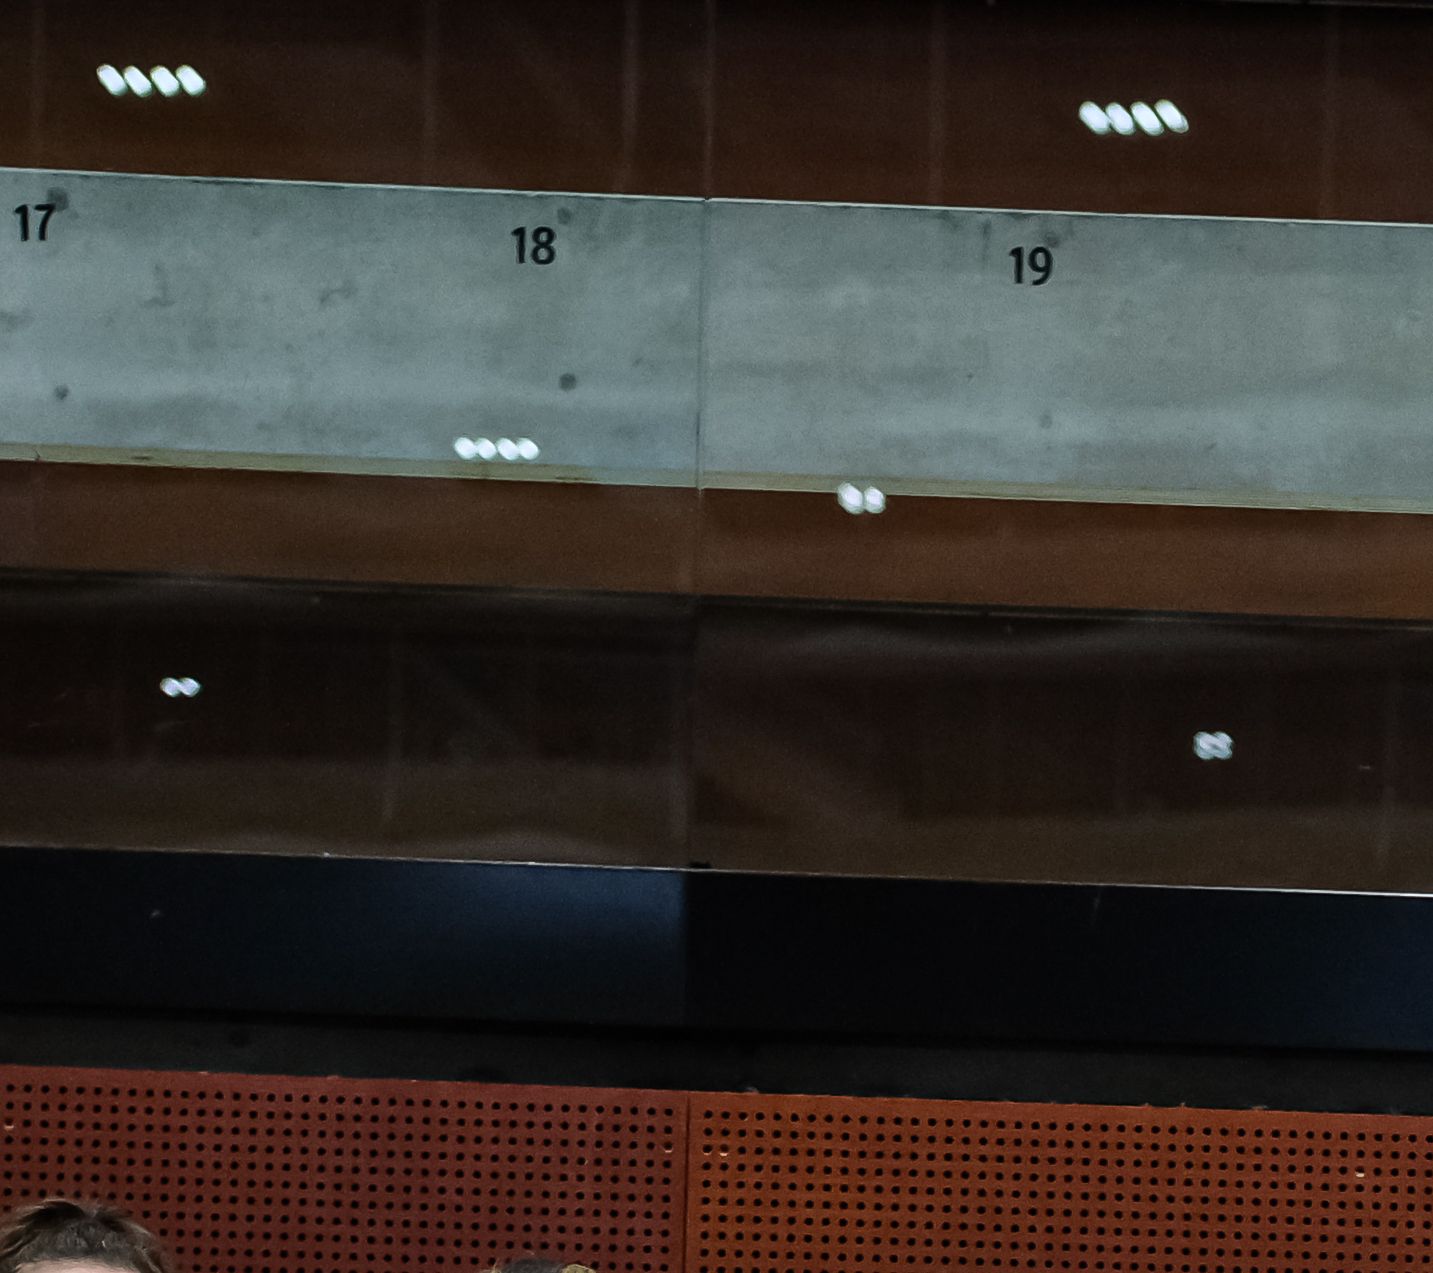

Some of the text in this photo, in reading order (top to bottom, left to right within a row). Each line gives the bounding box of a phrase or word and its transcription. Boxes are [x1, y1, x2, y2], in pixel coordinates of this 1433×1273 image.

[15, 204, 56, 242] 17
[512, 226, 556, 265] 18
[1009, 246, 1053, 286] 19
